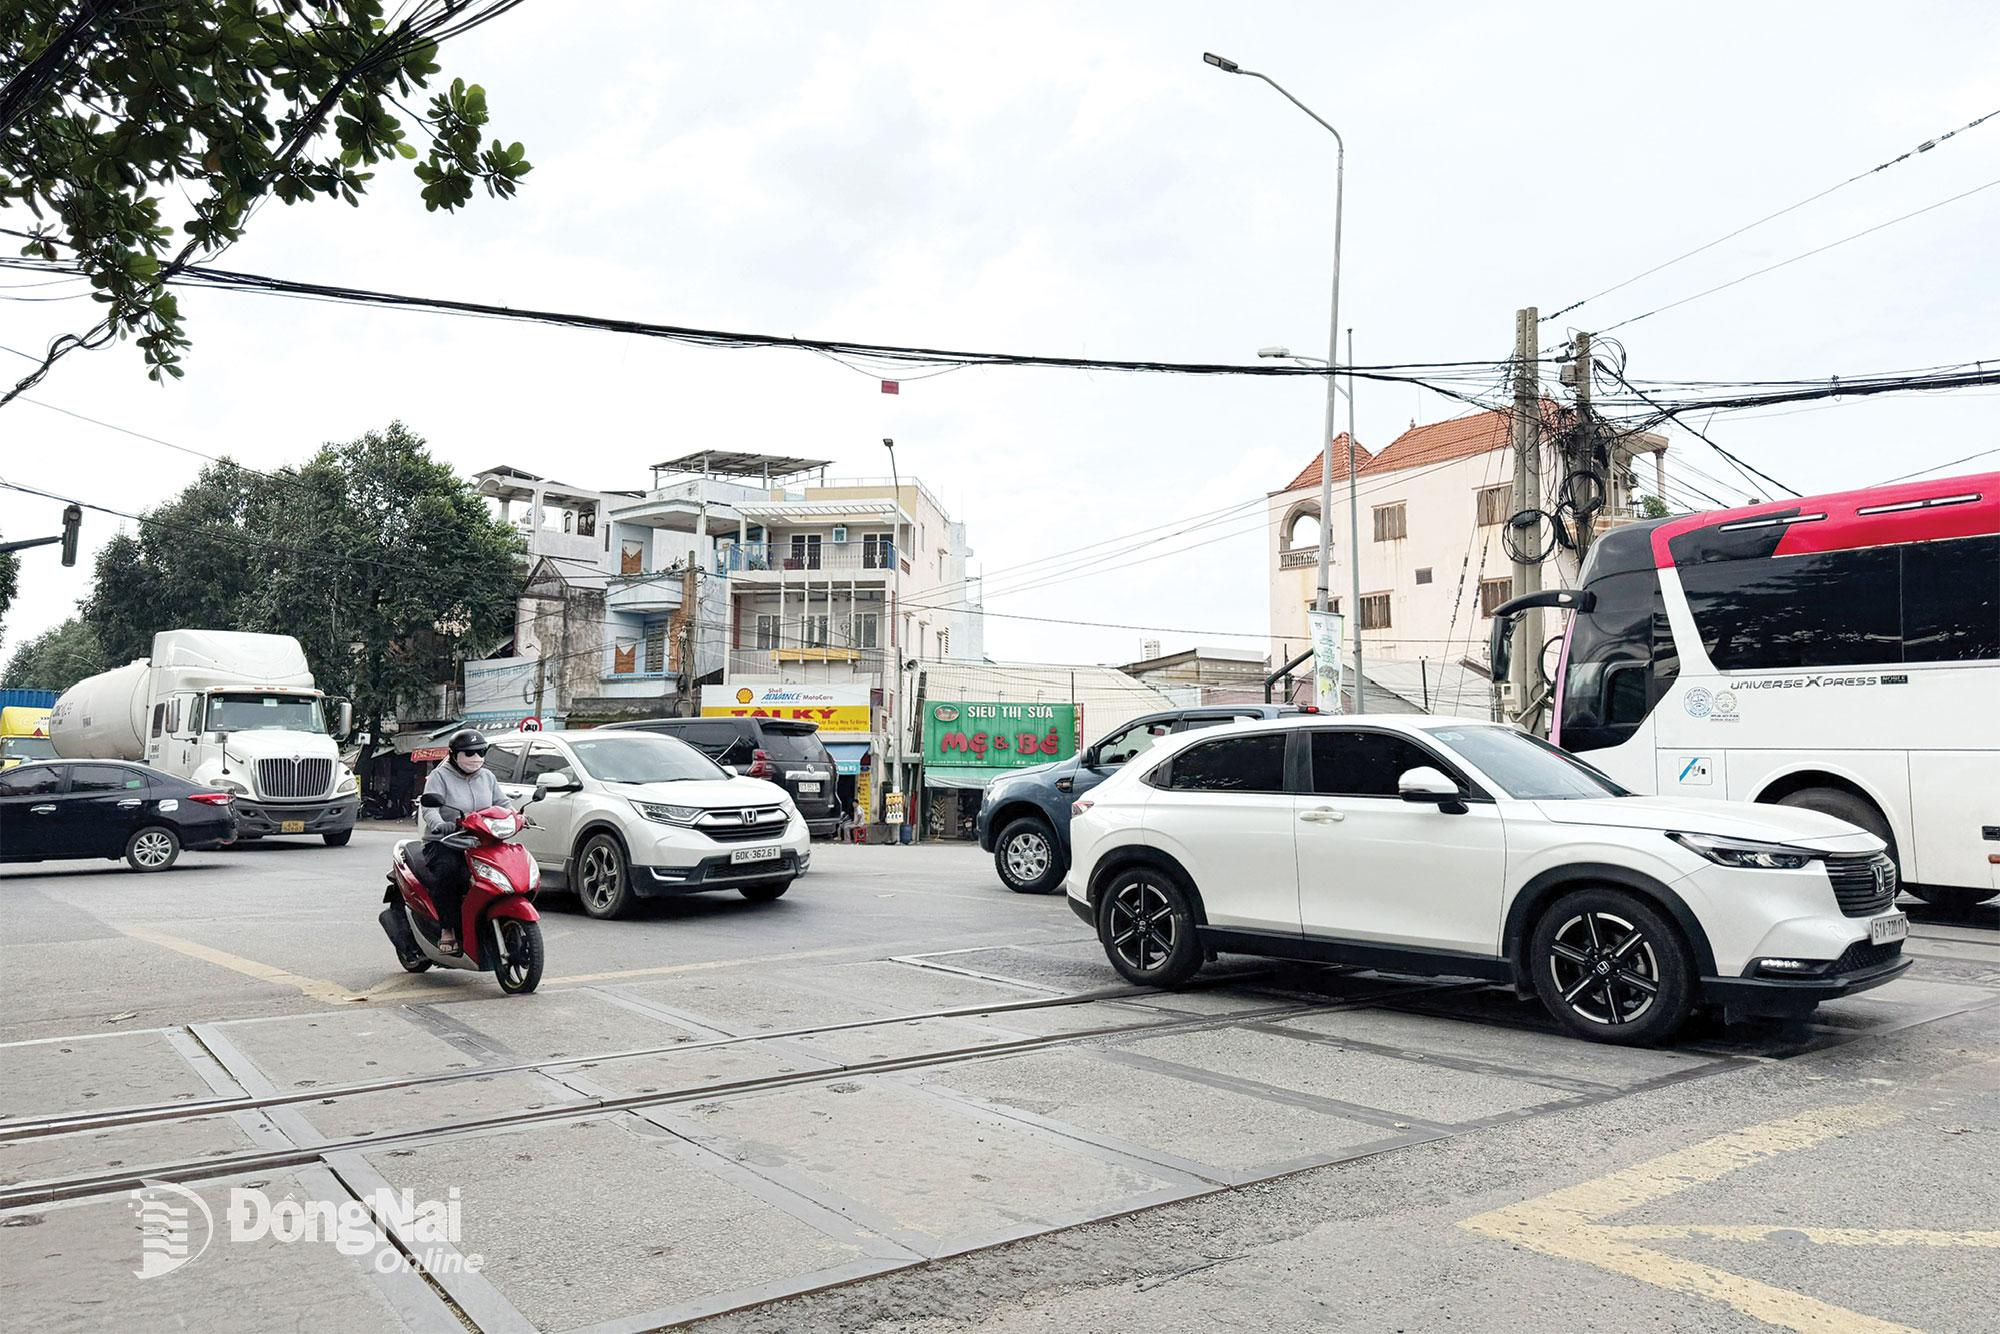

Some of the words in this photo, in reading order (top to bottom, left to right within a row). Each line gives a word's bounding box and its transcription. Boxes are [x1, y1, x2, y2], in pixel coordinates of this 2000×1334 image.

[1730, 679, 1804, 690] UNIVERSE
[761, 692, 803, 701] ADVANCE
[967, 703, 996, 718] SIÊU
[1002, 706, 1021, 721] THỊ
[1028, 702, 1054, 718] SỮA
[993, 735, 1009, 750] &
[735, 848, 777, 861] 60K-362.61
